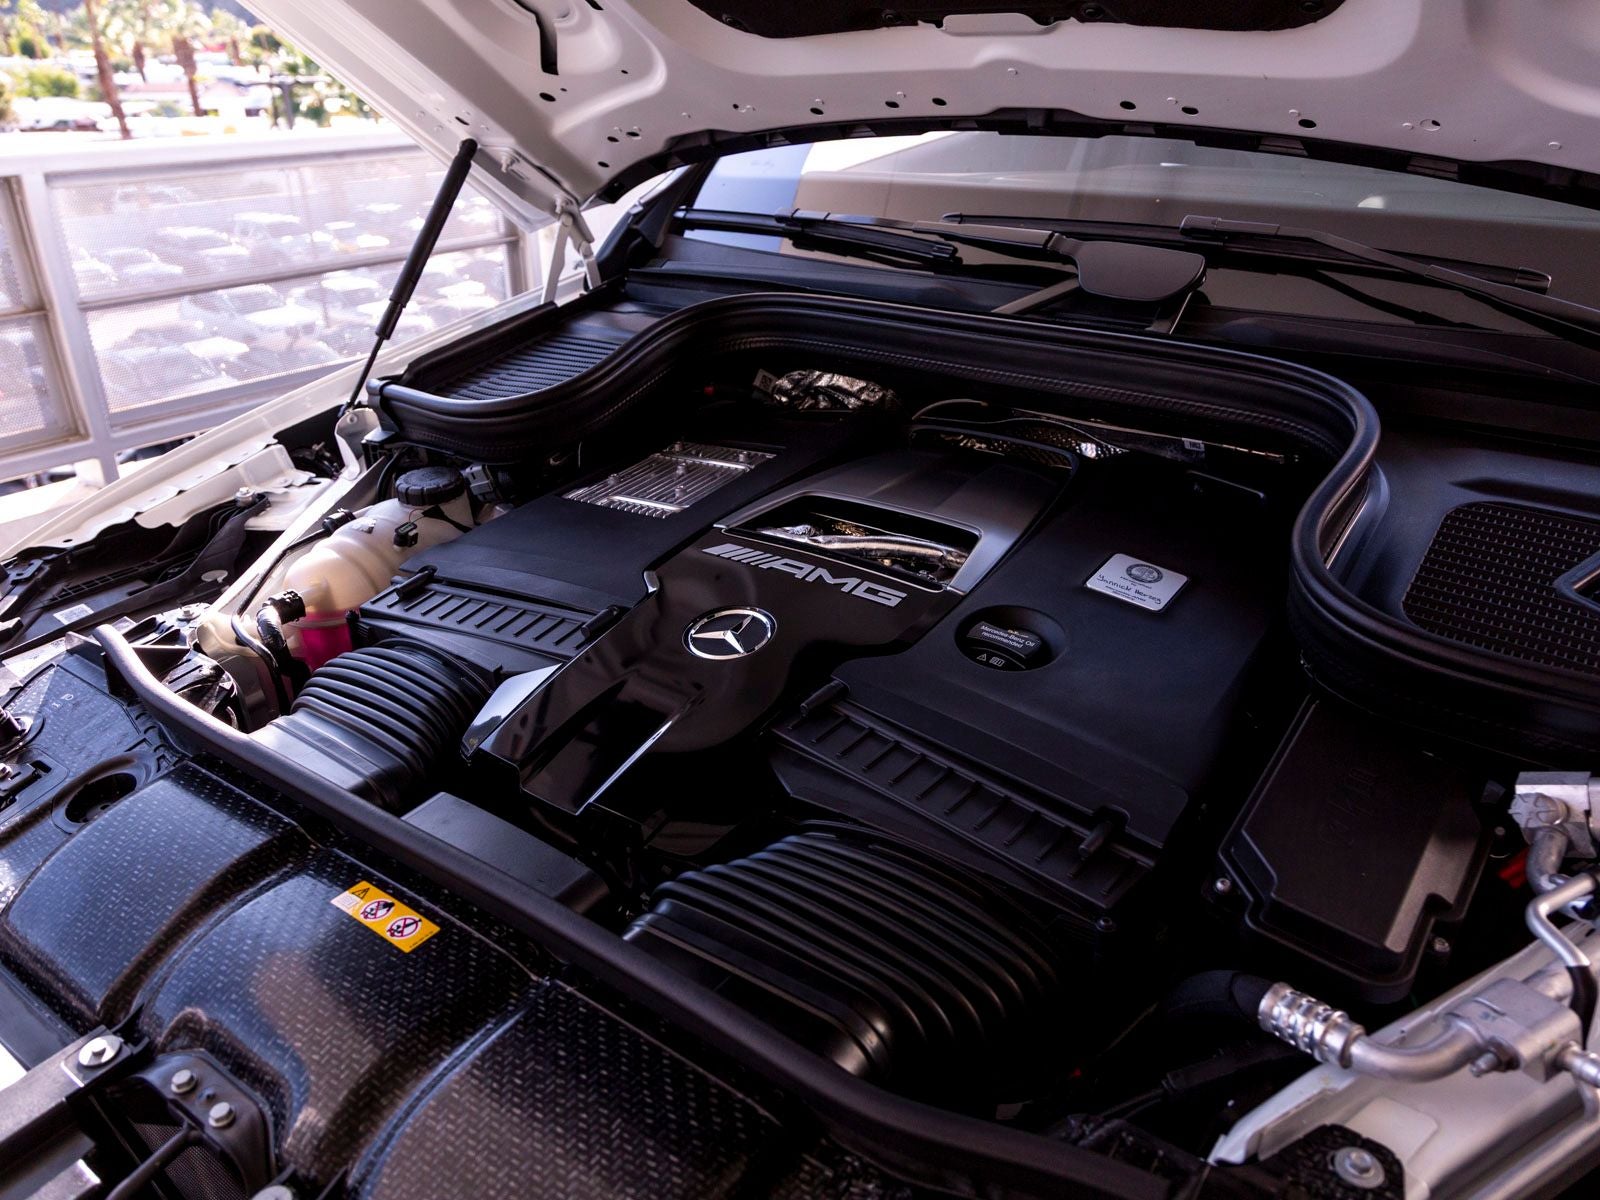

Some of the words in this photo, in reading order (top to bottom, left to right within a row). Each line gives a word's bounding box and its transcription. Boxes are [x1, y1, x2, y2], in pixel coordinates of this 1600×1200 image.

[758, 556, 908, 608] AMG
[980, 625, 1025, 644] Mercedes-Benz
[1025, 639, 1036, 648] Oil
[981, 631, 1024, 649] recommended
